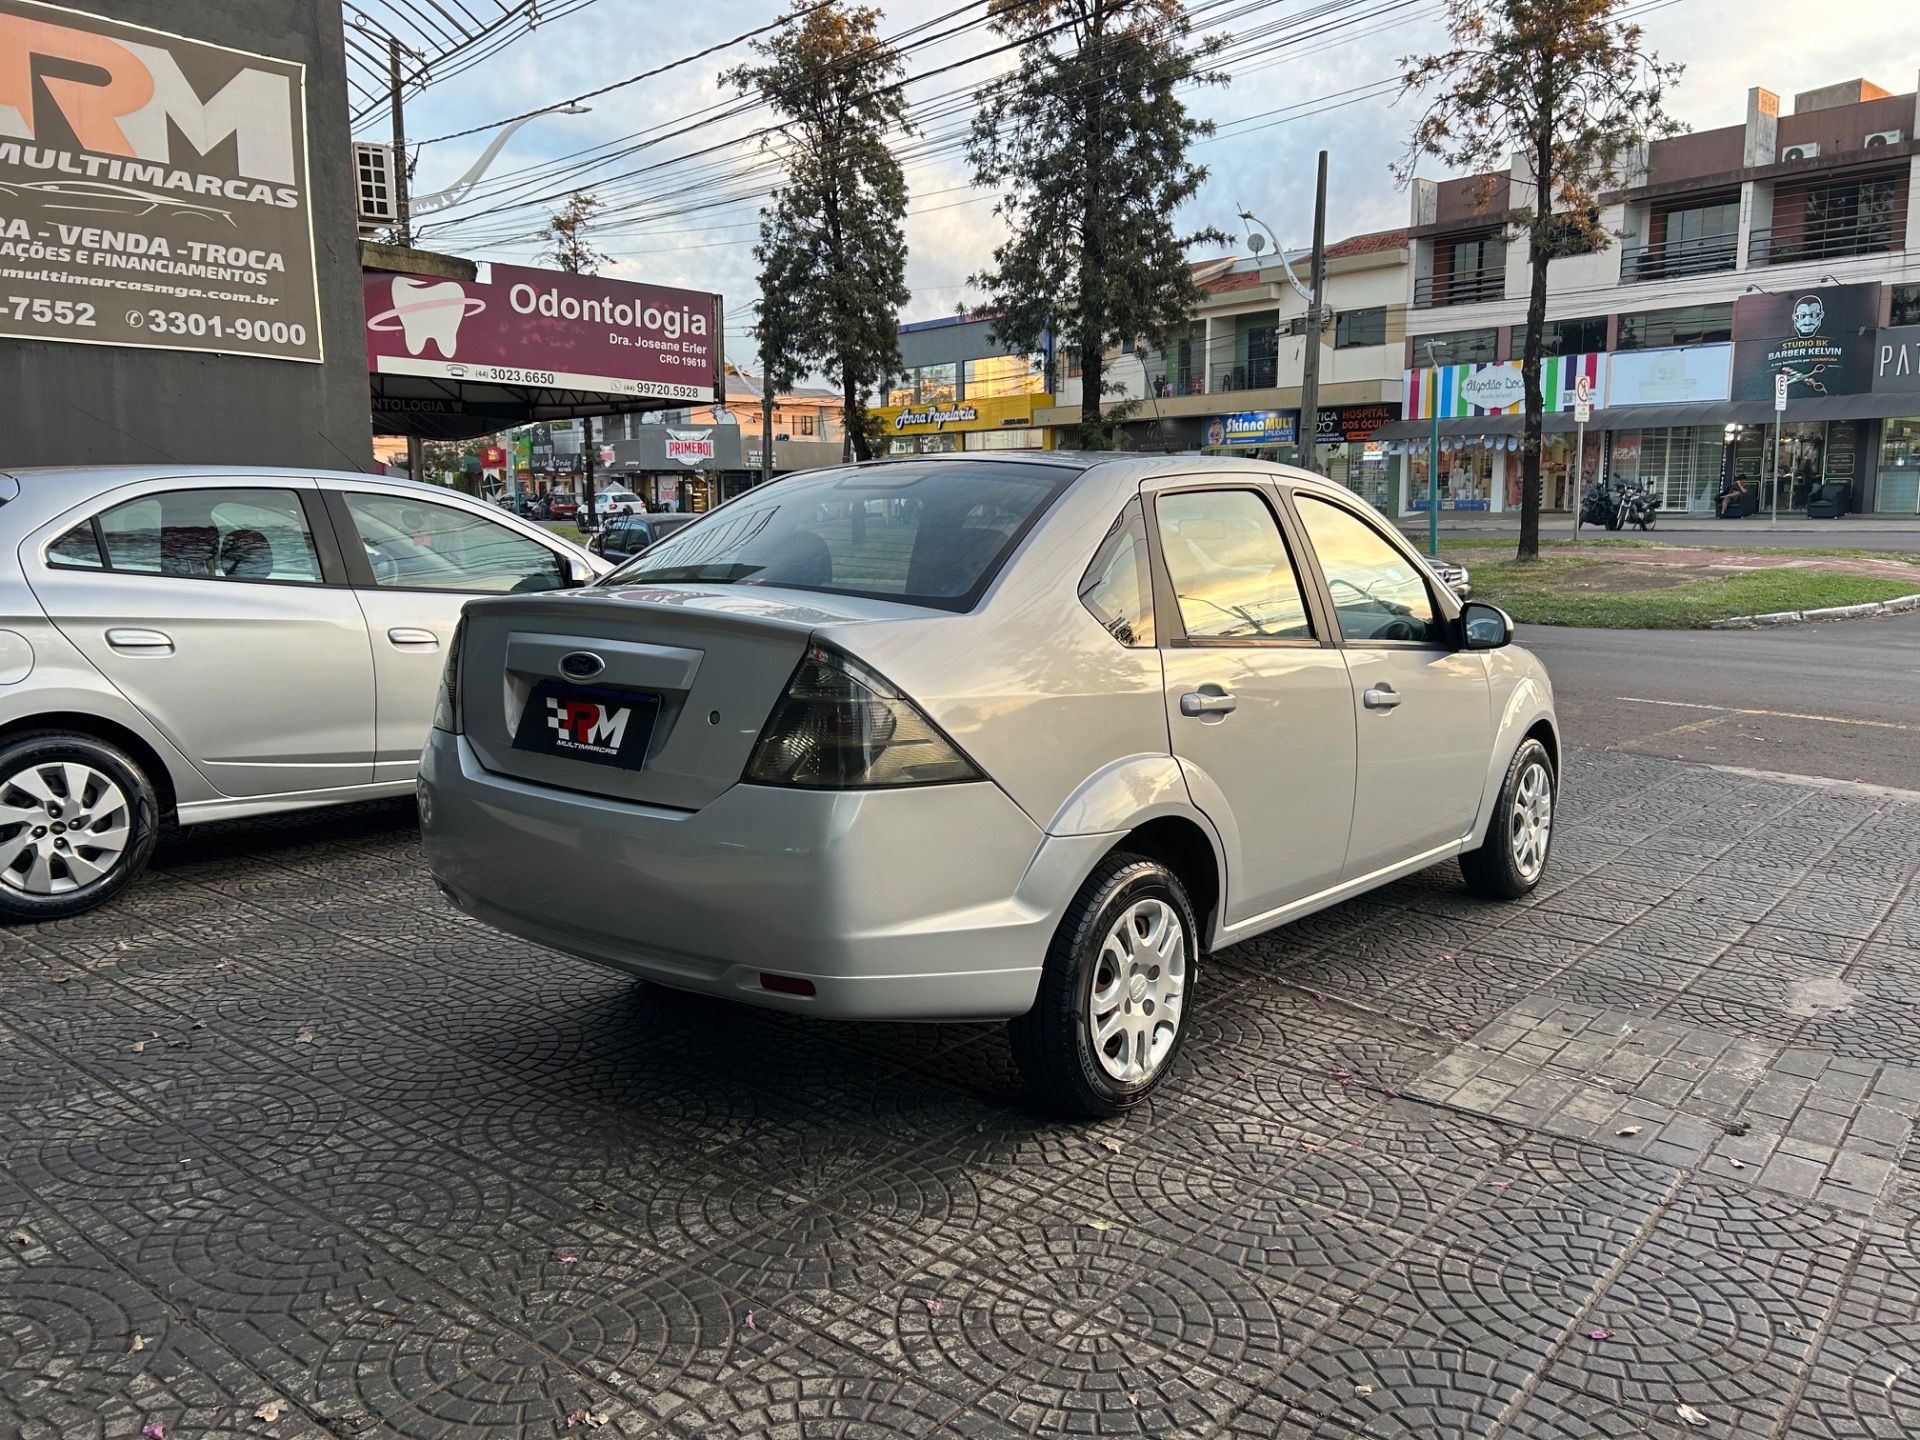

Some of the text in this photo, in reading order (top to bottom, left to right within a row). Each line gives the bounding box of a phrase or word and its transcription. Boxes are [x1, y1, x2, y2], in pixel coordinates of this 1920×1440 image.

[0, 142, 298, 209] MULTIMARCAS
[58, 224, 171, 257] VENDA
[76, 250, 89, 264] E
[93, 252, 267, 285] FINANCIAMENTOS
[0, 268, 279, 306] multimarcasmga.com.br
[509, 283, 707, 338] Odontologia
[148, 309, 306, 346] 3301-9000
[609, 333, 707, 354] Dra. Joseane Erler
[1782, 340, 1814, 349] STUDIO
[659, 354, 707, 367] CRO 19618
[1768, 349, 1806, 360] BARBER
[475, 367, 555, 385] (44) 3023.6650
[624, 382, 699, 399] (44) 99720.5928
[1466, 379, 1503, 393] Algodão
[895, 404, 976, 430] Anna Papelaria
[1342, 408, 1389, 419] HOSPITAL
[1342, 421, 1359, 429] DOS
[669, 442, 712, 457] PRIMEBOI
[568, 657, 591, 672] Ford
[562, 701, 632, 749] RM
[556, 739, 618, 755] MULTIMARCAS
